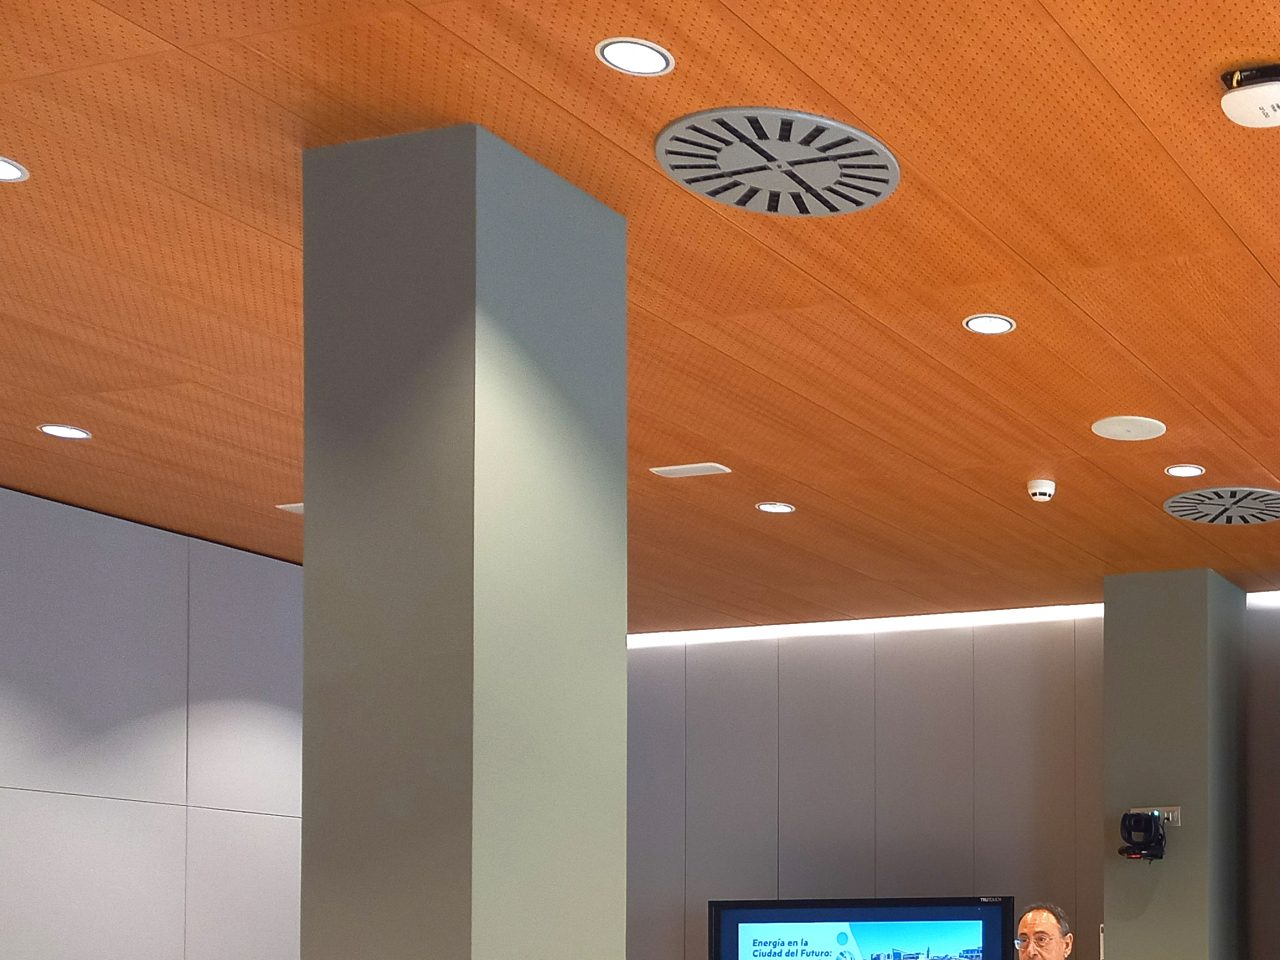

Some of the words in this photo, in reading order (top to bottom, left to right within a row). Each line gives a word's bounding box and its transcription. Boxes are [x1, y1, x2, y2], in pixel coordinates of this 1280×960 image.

[753, 938, 784, 948] Energía
[801, 938, 808, 946] la
[753, 949, 782, 957] Ciudad
[785, 949, 798, 957] del
